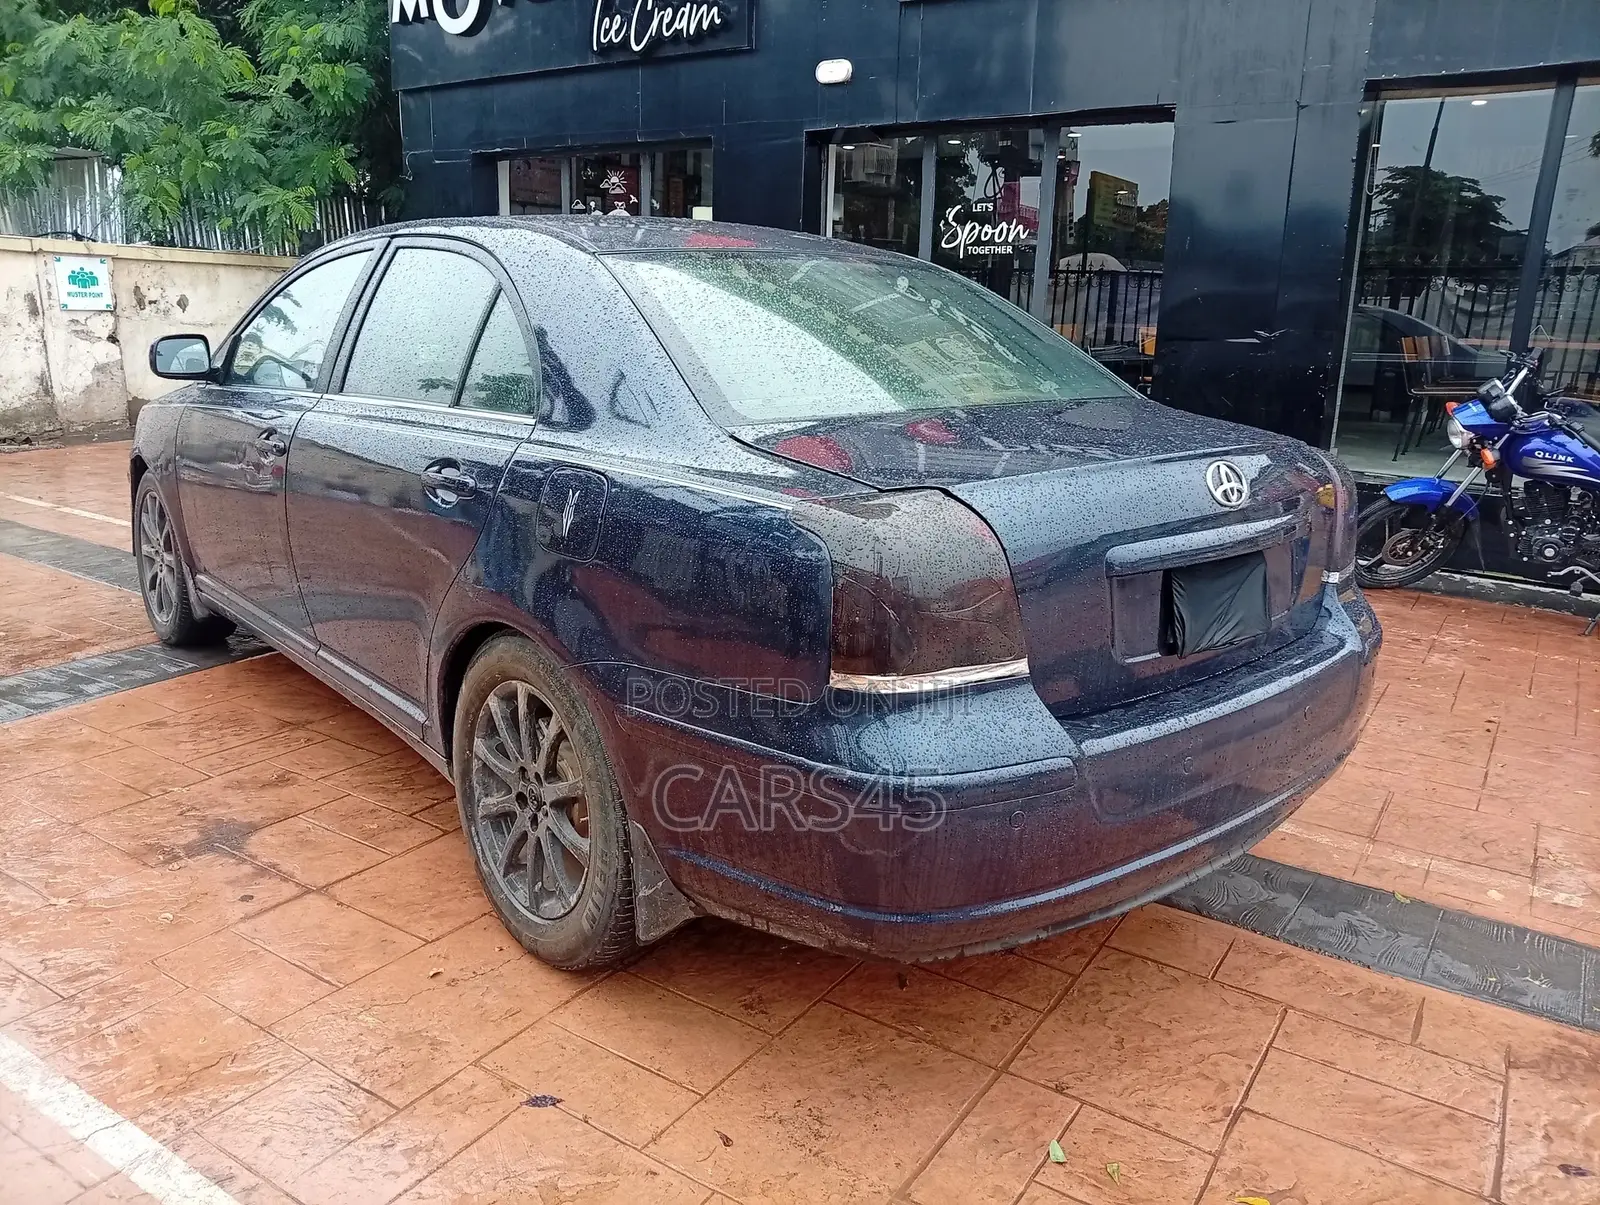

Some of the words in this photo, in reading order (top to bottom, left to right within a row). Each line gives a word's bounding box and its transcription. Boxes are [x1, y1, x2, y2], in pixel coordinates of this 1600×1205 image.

[593, 0, 627, 51] Ice
[630, 0, 721, 51] Cream
[972, 203, 994, 212] LET'S
[940, 205, 1029, 259] Spoon
[967, 245, 1013, 255] TOGETHER
[1535, 450, 1574, 463] QLINK
